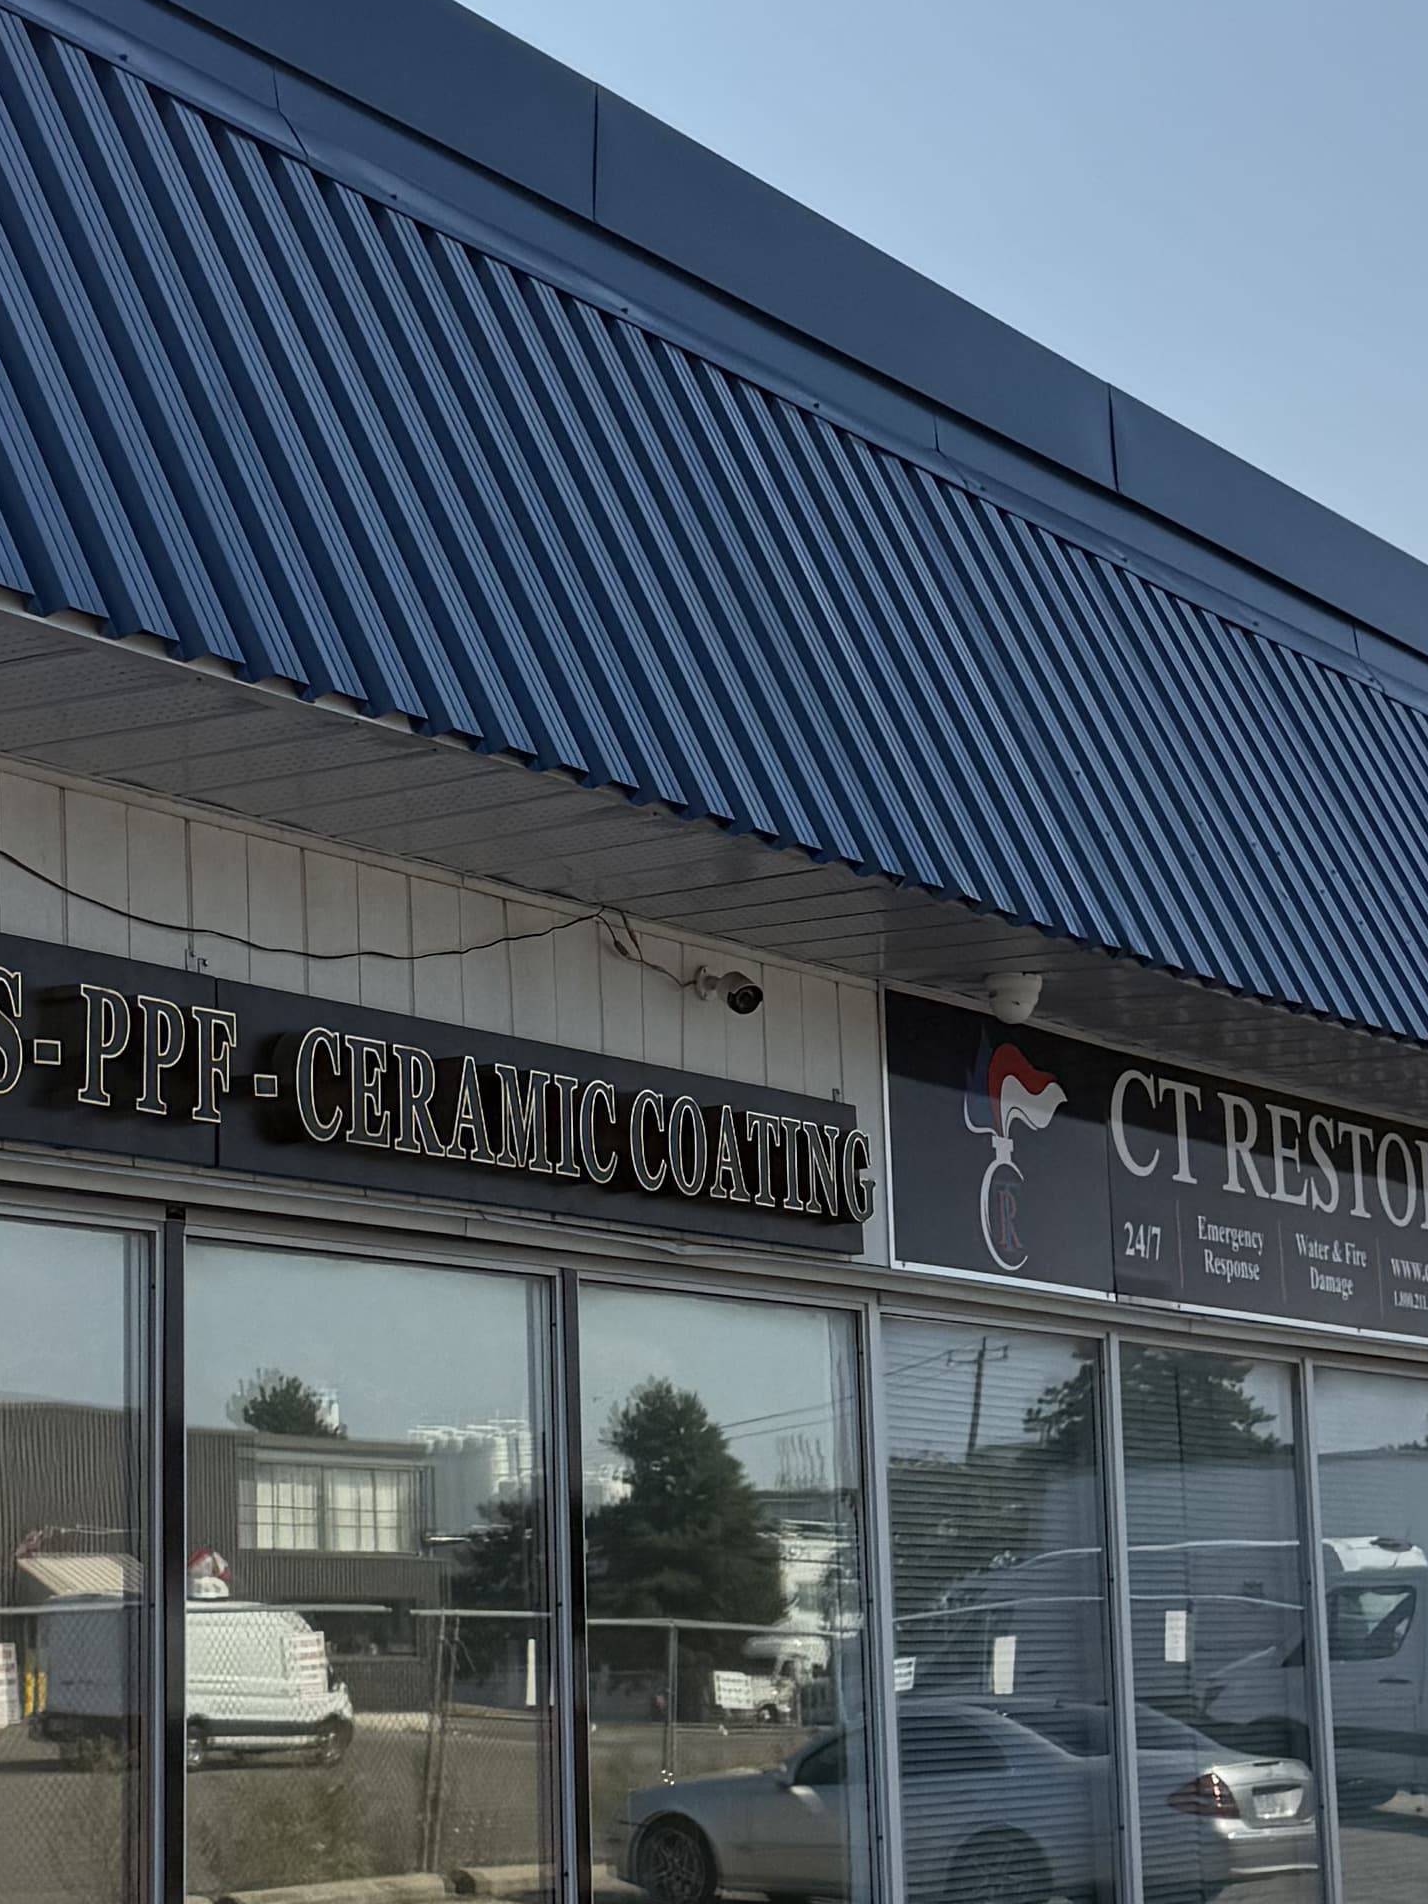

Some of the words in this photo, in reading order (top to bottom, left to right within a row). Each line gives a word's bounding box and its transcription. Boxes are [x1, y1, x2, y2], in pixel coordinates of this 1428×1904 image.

[75, 981, 239, 1126] PPF
[293, 1025, 618, 1186] CERAMIC
[628, 1087, 877, 1225] COATING
[1109, 1067, 1202, 1186] CT
[1123, 1221, 1162, 1262] 24/7
[1197, 1214, 1265, 1256] Emergency
[1295, 1231, 1329, 1262] Water
[1330, 1240, 1343, 1265] &
[1344, 1241, 1368, 1269] Fire
[1203, 1248, 1261, 1285] Response
[1309, 1266, 1354, 1301] Damage
